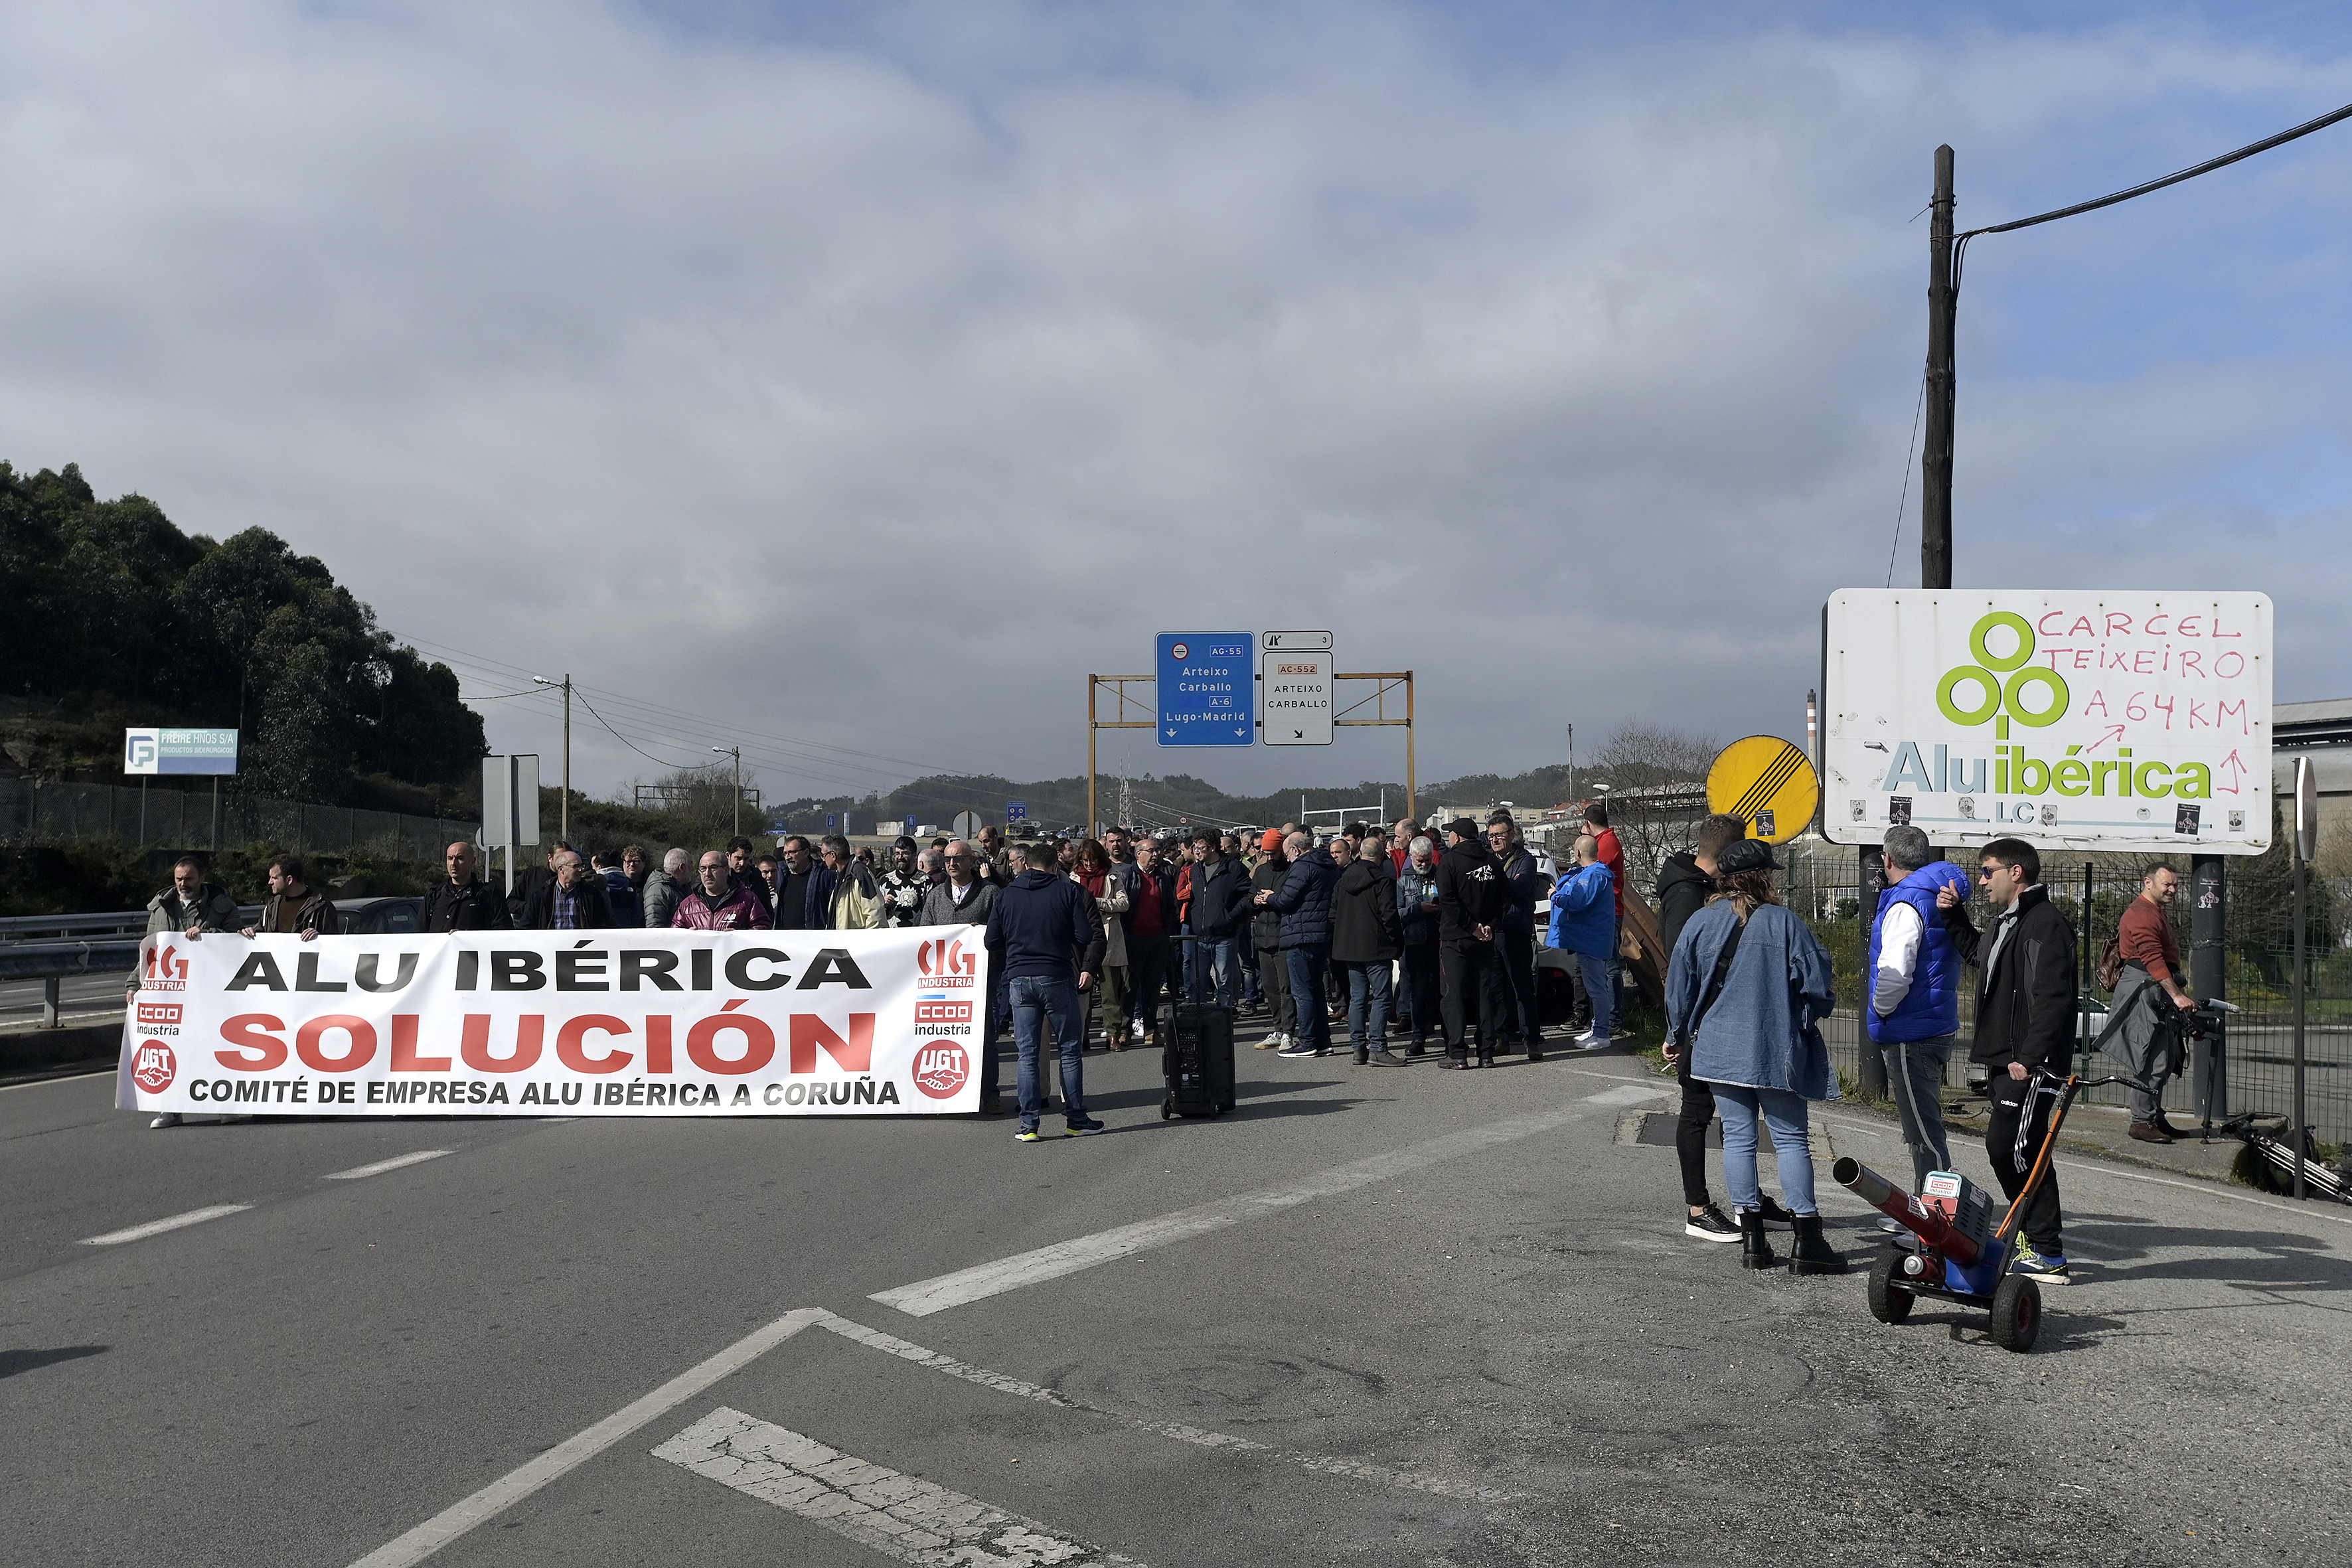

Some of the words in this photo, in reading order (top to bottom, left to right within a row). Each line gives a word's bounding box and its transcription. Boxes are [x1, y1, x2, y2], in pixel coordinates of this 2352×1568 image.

[2038, 610, 2242, 638] CARCEL
[1212, 647, 1241, 656] AG-55
[1182, 666, 1229, 676] Arteixo
[1179, 682, 1231, 692] Carballo
[2084, 689, 2108, 718] A
[1166, 712, 1245, 724] Lugo-Madrid
[161, 733, 191, 744] FREIRE
[193, 733, 217, 744] HNOS
[218, 733, 234, 744] S/A
[1881, 741, 2213, 799] Aluibérica
[917, 939, 976, 976] CIG
[224, 951, 420, 992] ALU
[455, 940, 873, 992] IBÉRICA
[918, 977, 974, 988] INDUSTRIA
[139, 1006, 179, 1020] CCOO
[918, 1006, 969, 1018] CCOO
[137, 1023, 179, 1036] industria
[915, 1023, 971, 1036] industria
[214, 999, 876, 1075] SOLUCIÓN
[138, 1047, 170, 1069] UGT
[919, 1049, 963, 1071] UGT
[189, 1075, 308, 1103] COMITÉ
[317, 1081, 355, 1104] DE
[367, 1081, 509, 1104] EMPRESA
[519, 1082, 582, 1105] ALU
[593, 1077, 721, 1106] IBÉRICA
[731, 1083, 752, 1106] A
[763, 1076, 900, 1106] CORUÑA
